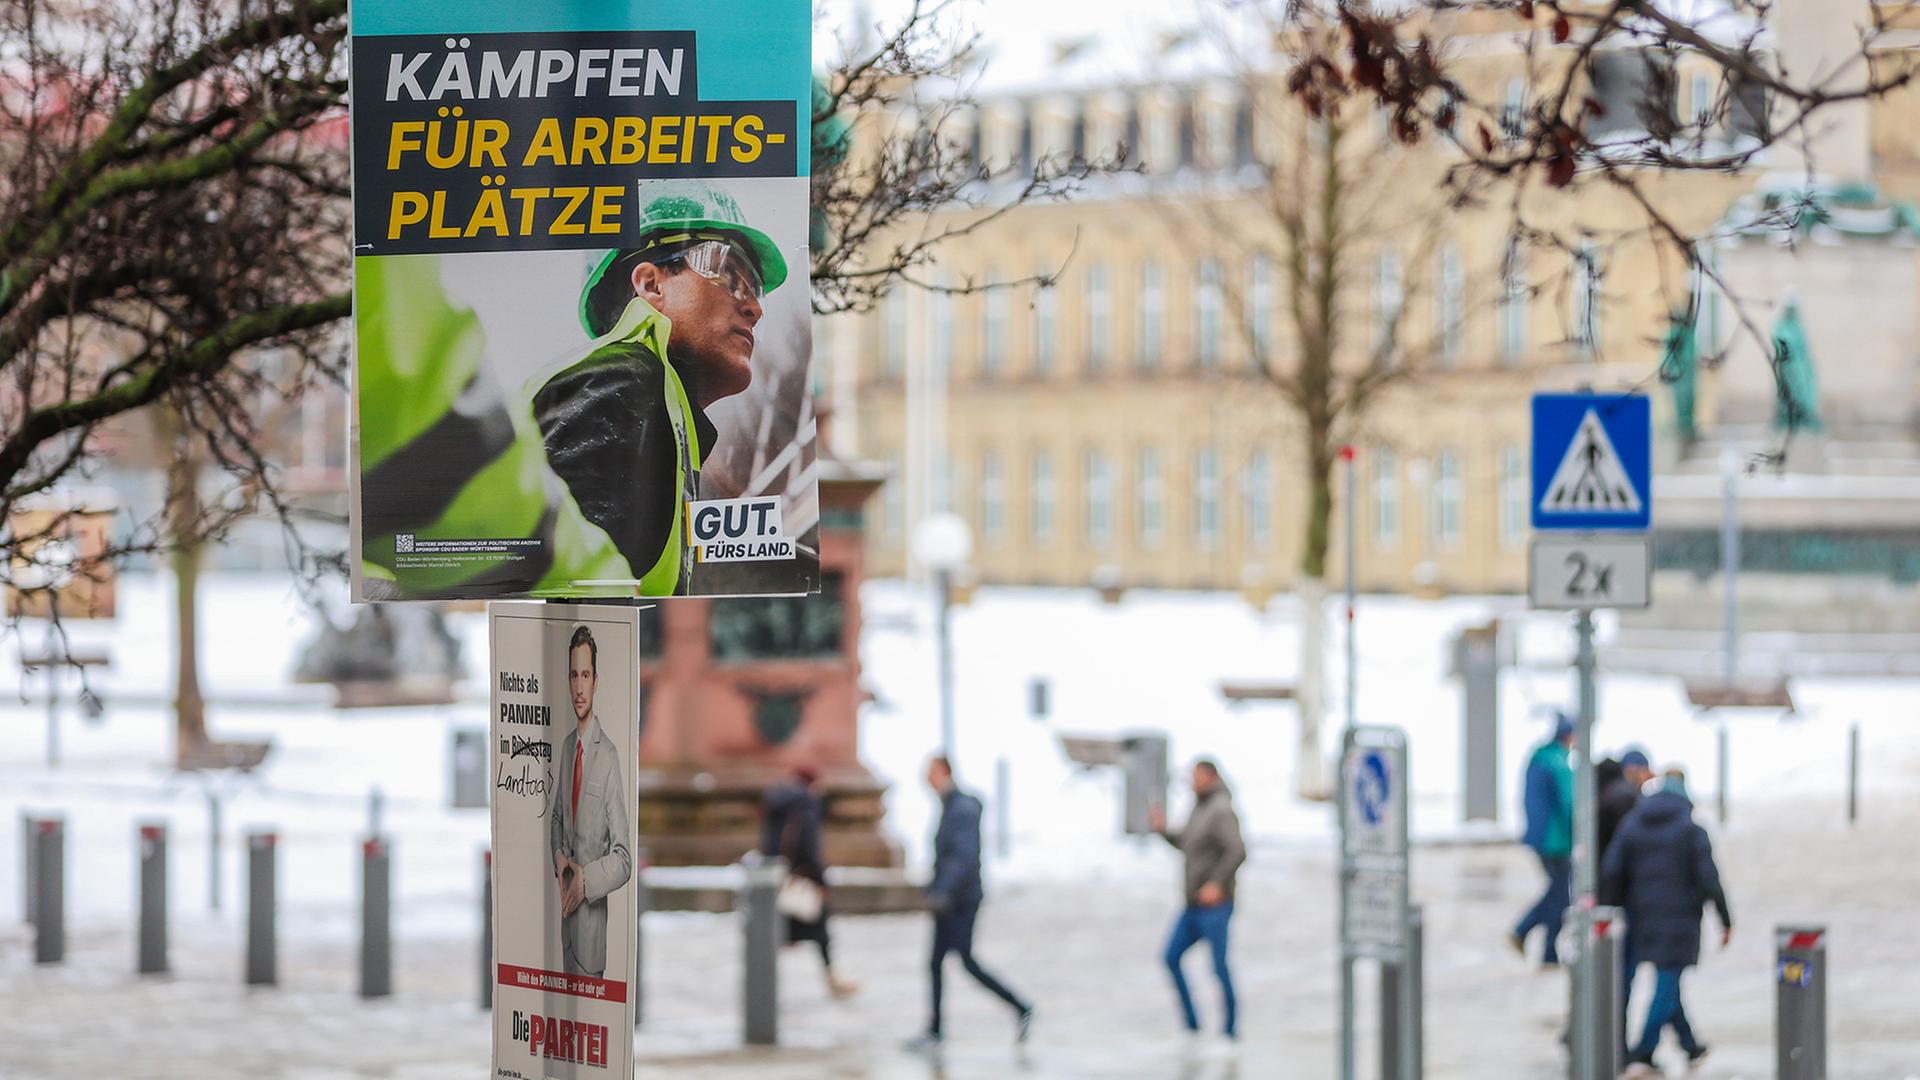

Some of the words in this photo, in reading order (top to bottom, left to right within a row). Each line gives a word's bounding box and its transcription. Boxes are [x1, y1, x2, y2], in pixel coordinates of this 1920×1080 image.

[386, 37, 684, 101] KÄMPFEN
[387, 106, 510, 170] FÜR
[522, 114, 786, 167] ARBEITS-
[387, 175, 625, 240] PLÄTZE
[694, 502, 777, 540] GUT.
[705, 540, 745, 559] FÜRS
[747, 542, 793, 557] LAND.
[1564, 551, 1614, 598] 2x
[500, 672, 525, 693] Nichts
[526, 674, 539, 693] als
[500, 703, 550, 726] PANNEN
[501, 734, 510, 754] im
[539, 974, 568, 990] PANNEN
[512, 1010, 530, 1042] Die
[529, 1014, 608, 1068] PARTEI
